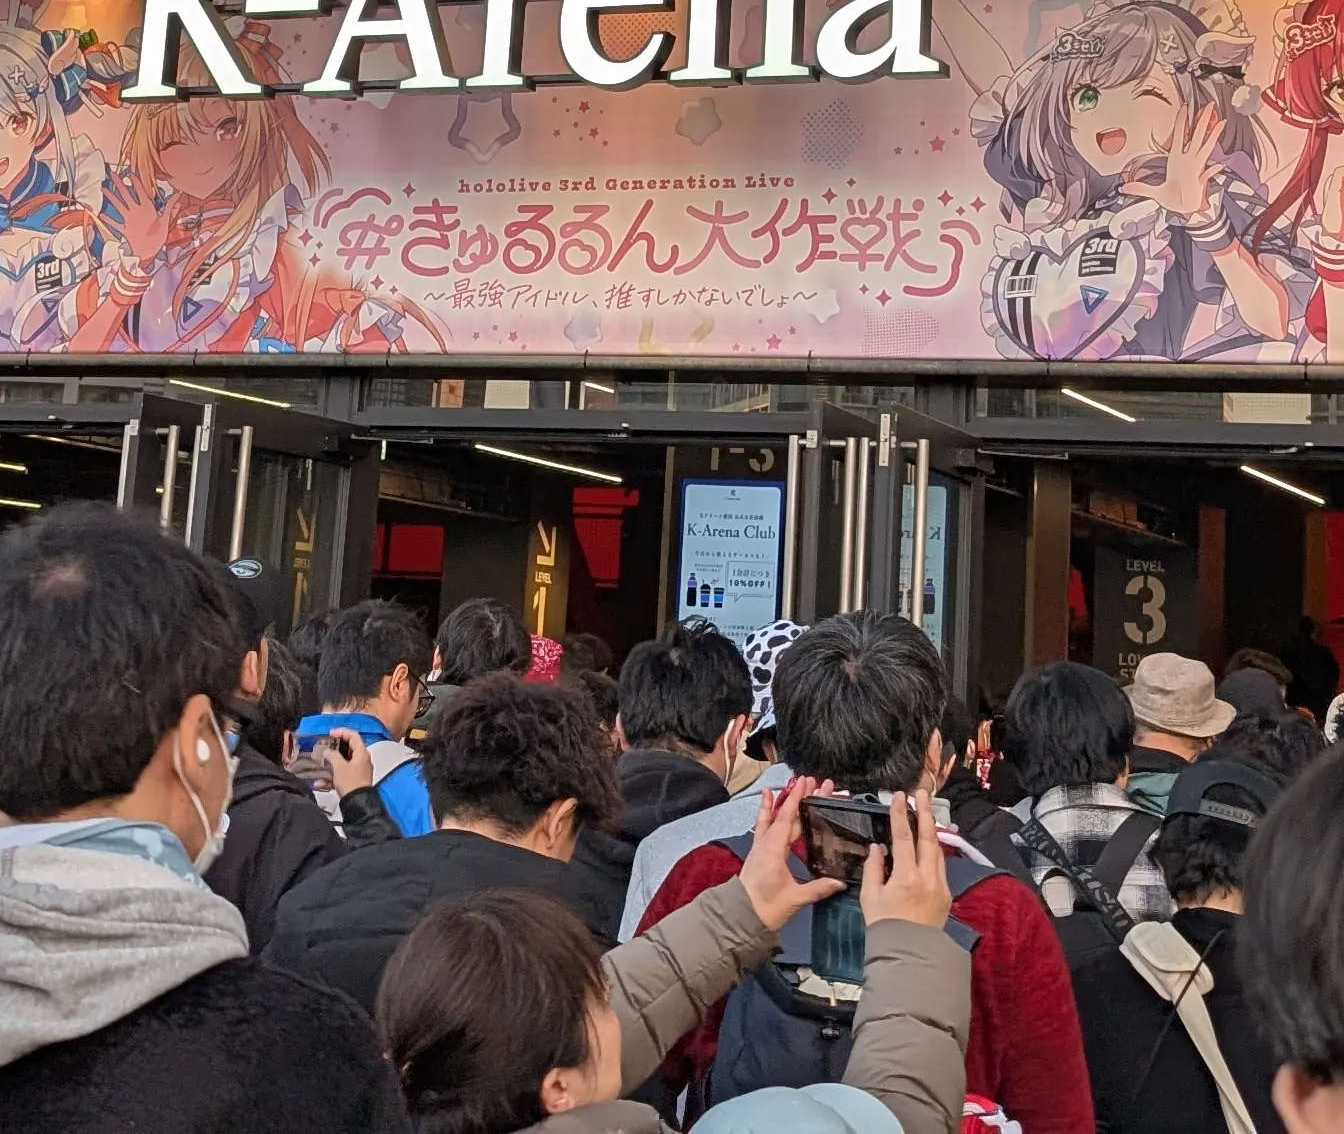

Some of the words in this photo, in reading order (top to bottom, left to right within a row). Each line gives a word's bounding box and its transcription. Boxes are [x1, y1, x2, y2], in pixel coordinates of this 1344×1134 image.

[457, 177, 552, 194] hololive
[558, 176, 597, 192] 3rd
[605, 173, 737, 191] Generation
[744, 172, 795, 189] Live
[687, 522, 740, 539] K-Arena
[744, 524, 776, 540] Club
[1126, 559, 1165, 572] LEVEL
[1123, 575, 1167, 644] 3
